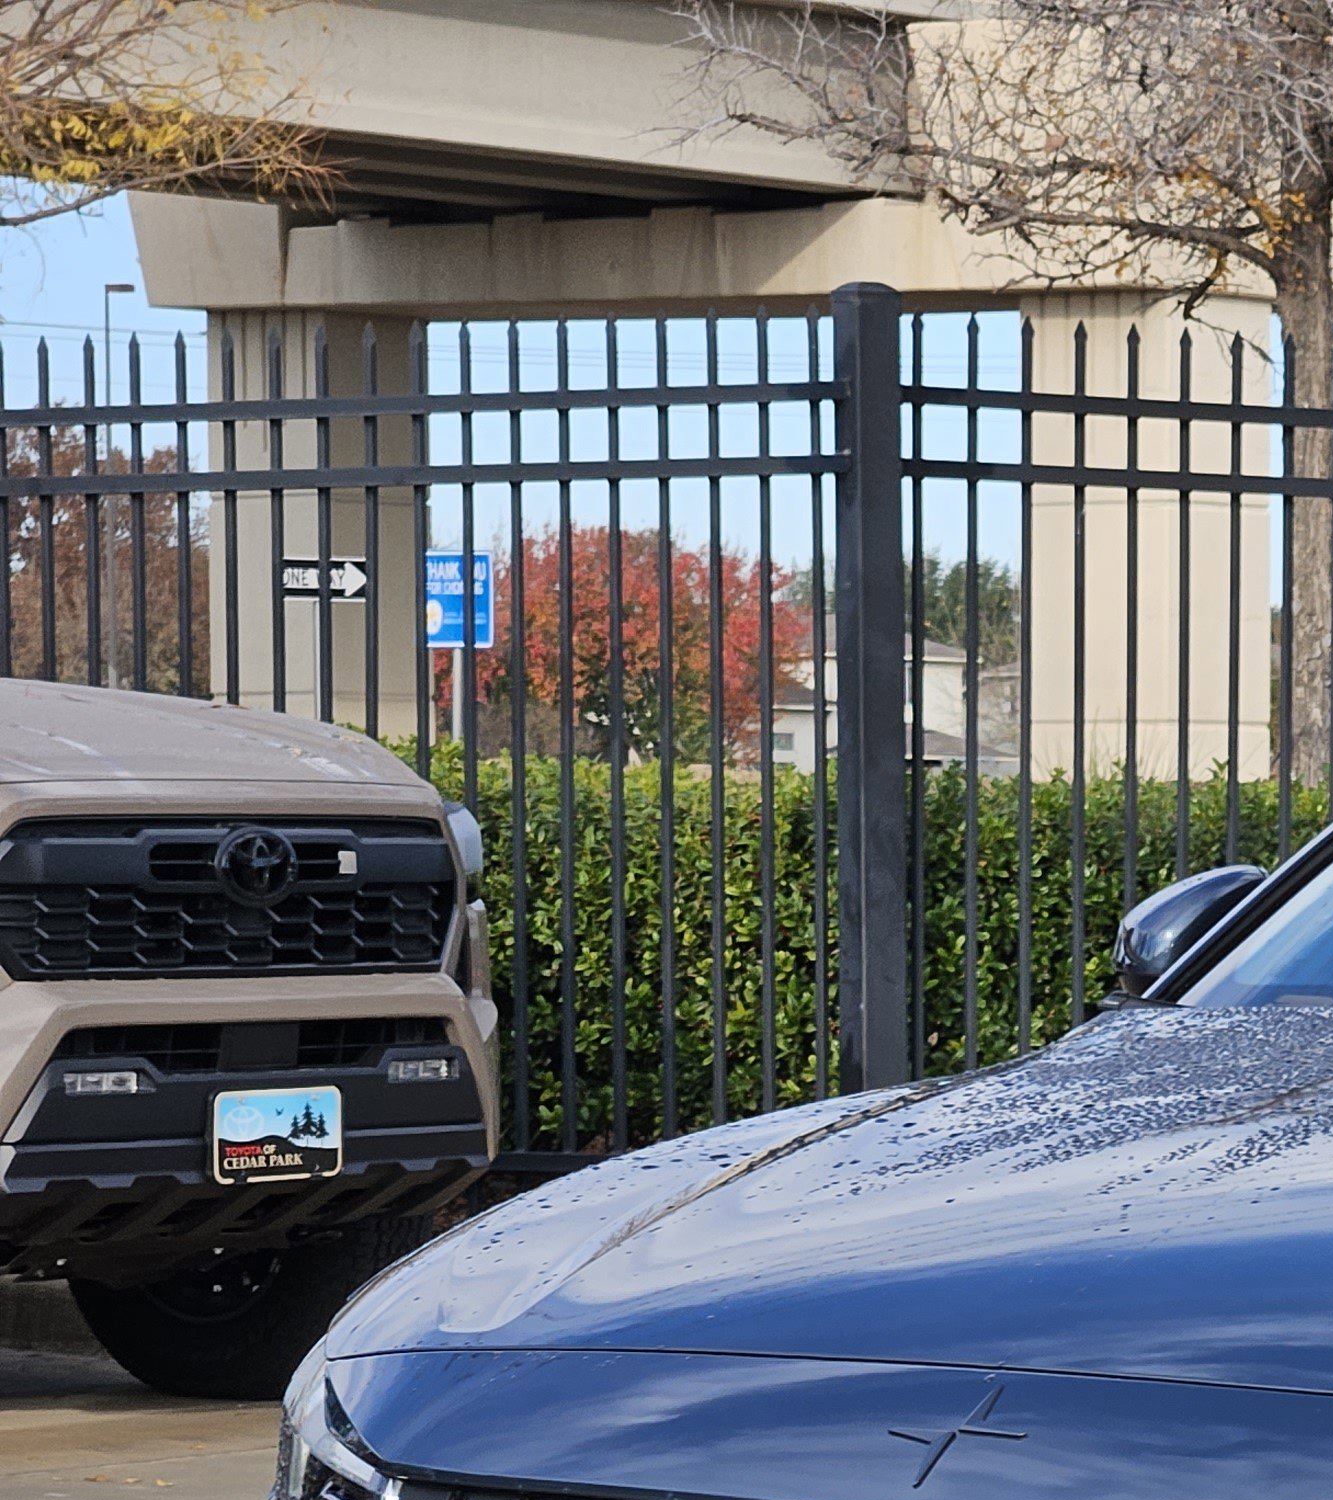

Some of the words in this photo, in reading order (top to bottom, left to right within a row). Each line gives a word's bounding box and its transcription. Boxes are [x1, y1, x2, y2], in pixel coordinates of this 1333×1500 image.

[225, 1146, 262, 1157] TOYOTA
[263, 1144, 277, 1154] OF
[223, 1155, 267, 1170] CEDAR
[269, 1153, 303, 1167] PARK
